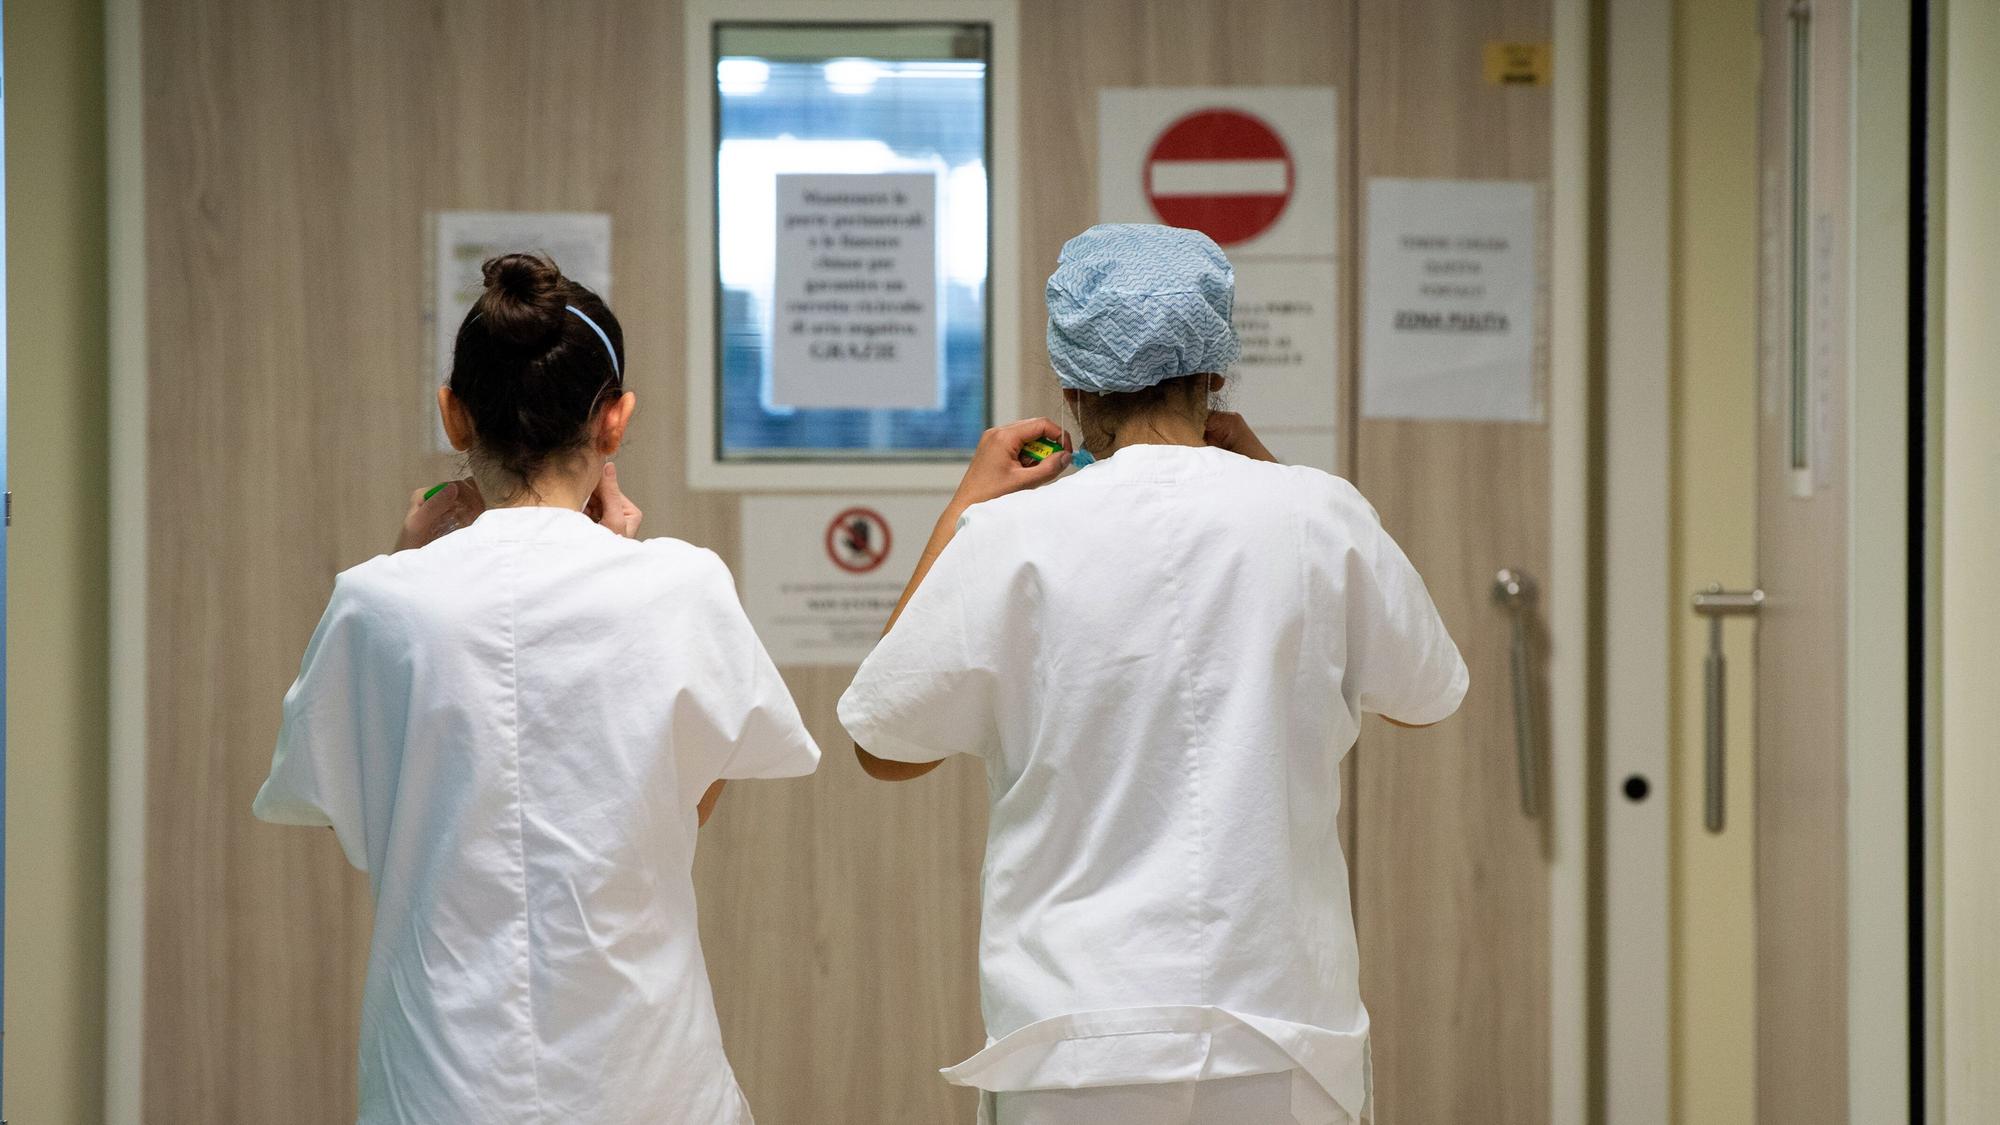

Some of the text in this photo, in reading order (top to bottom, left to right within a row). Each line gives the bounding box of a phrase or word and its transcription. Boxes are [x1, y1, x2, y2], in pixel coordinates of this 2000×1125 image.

[1394, 310, 1511, 331] ZONA PULITA
[808, 342, 897, 359] GRAZIE
